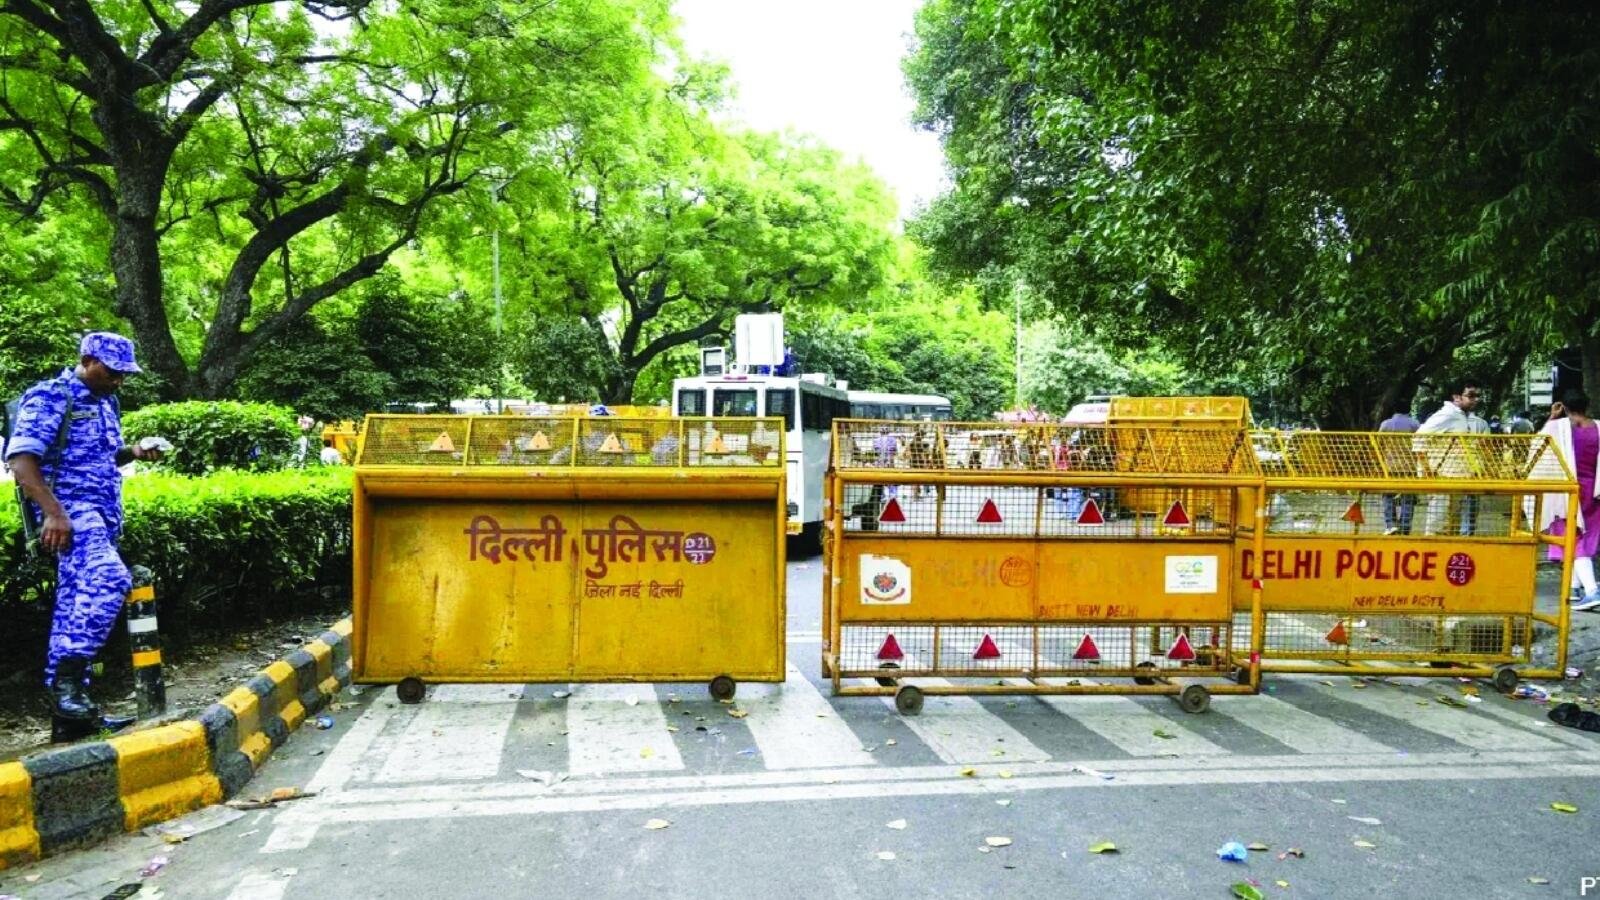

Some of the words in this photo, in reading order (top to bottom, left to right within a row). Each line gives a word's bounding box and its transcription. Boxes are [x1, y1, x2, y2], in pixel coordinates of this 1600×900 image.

[463, 514, 567, 565] दिल्ली
[582, 514, 684, 579] पुलिस
[1241, 549, 1322, 579] DELHI
[1336, 549, 1438, 580] POLICE
[648, 580, 684, 598] दिल्ली
[1378, 595, 1409, 607] DELHI
[1106, 604, 1139, 618] DELHI
